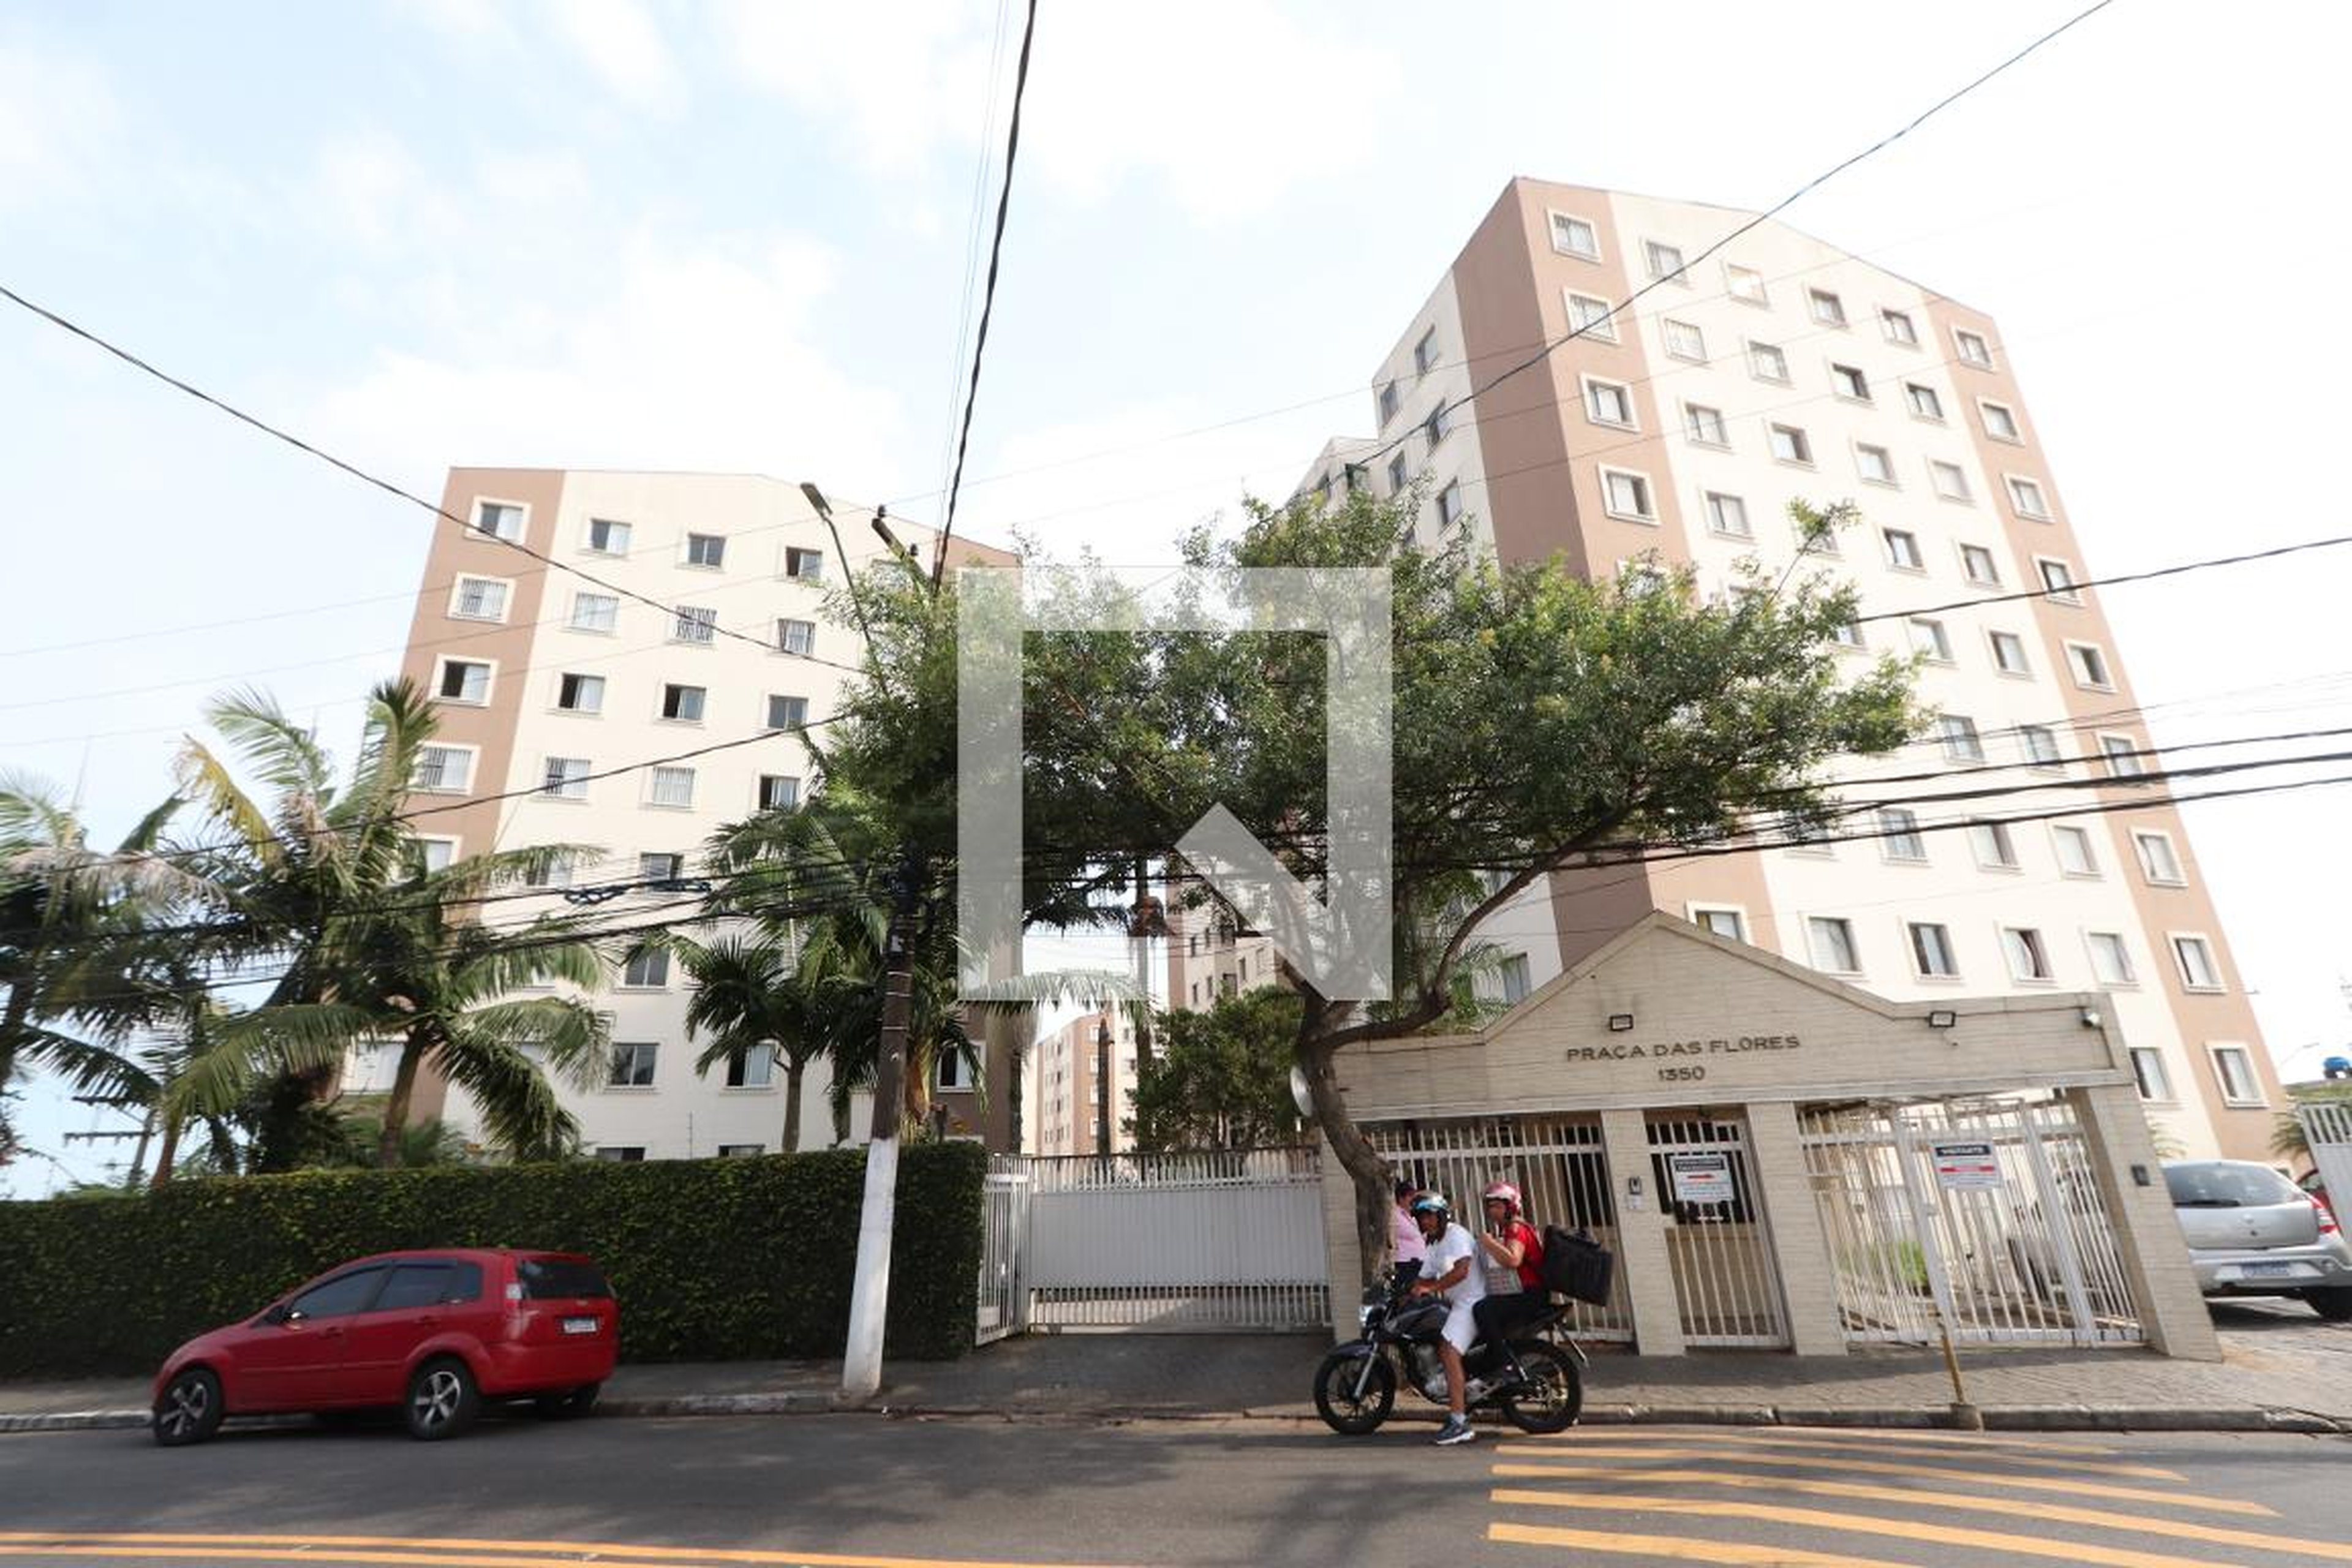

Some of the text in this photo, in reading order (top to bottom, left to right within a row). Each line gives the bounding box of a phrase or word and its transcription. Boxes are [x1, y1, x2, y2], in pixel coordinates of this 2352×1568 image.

[1653, 1041, 1702, 1057] DAS
[1709, 1036, 1801, 1053] FLORES
[1658, 1065, 1706, 1082] 1350
